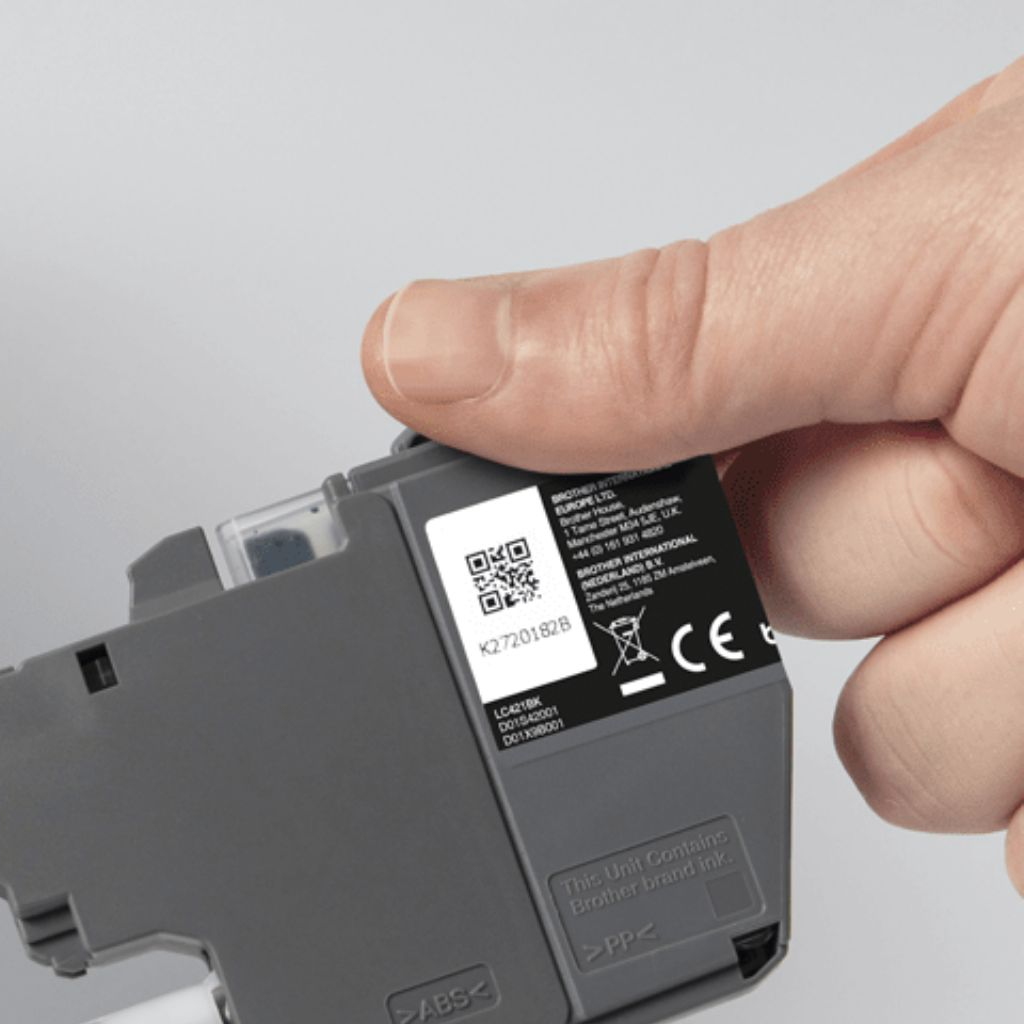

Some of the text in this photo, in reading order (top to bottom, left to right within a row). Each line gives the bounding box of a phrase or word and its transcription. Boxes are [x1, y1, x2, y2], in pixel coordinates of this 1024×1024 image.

[554, 495, 594, 516] EUROPE
[560, 511, 591, 527] Brother
[567, 528, 618, 548] Manchester
[619, 518, 639, 532] M34
[572, 521, 597, 534] Tame
[573, 548, 589, 559] +44
[577, 534, 698, 579] BROTHER INTERNATIONAL
[581, 556, 664, 592] (NEDERLAND) B.V.
[588, 602, 605, 613] The
[671, 611, 745, 672] CE
[494, 696, 542, 720] LC421BK
[559, 827, 729, 895] This Unit Contains
[569, 847, 734, 918] Brother brand ink.
